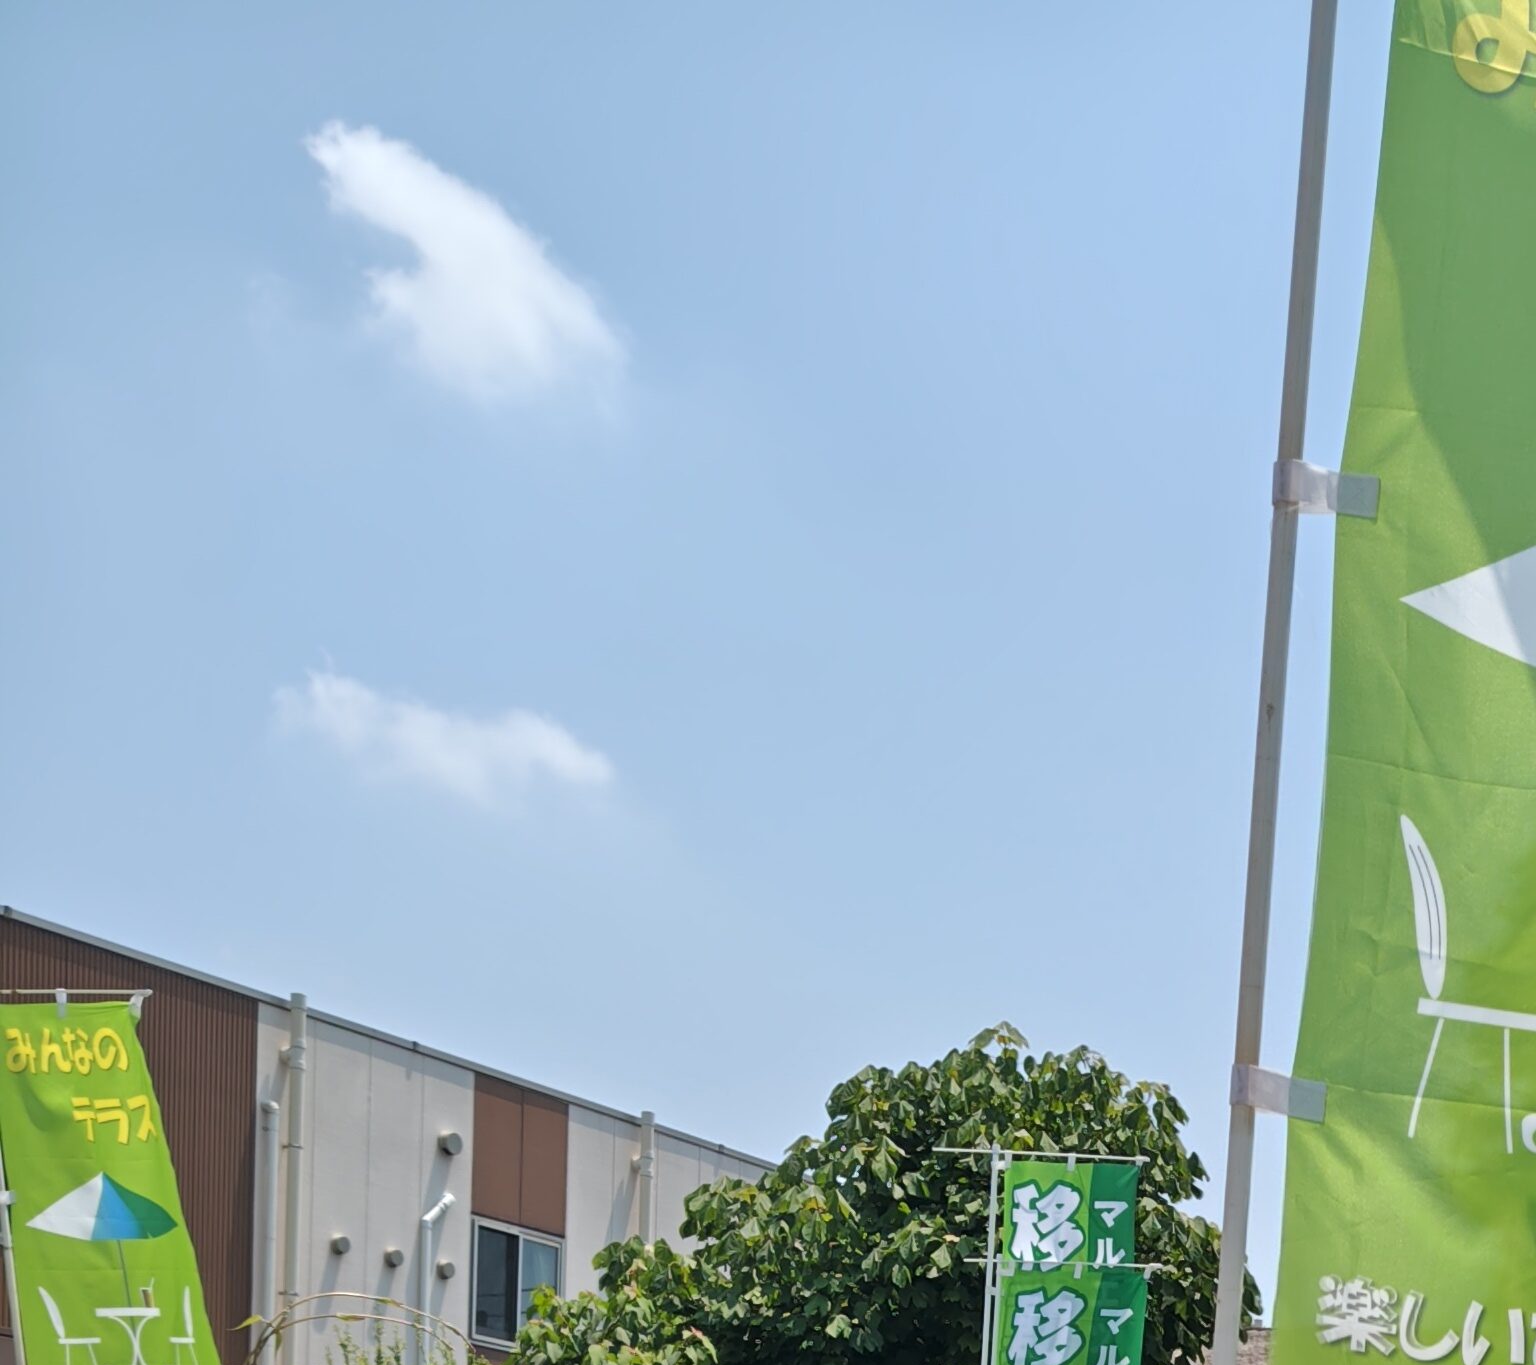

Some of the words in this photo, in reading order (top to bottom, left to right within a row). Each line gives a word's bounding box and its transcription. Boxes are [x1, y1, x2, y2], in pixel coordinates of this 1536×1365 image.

[6, 1027, 128, 1074] みんなの
[71, 1095, 157, 1145] テラス
